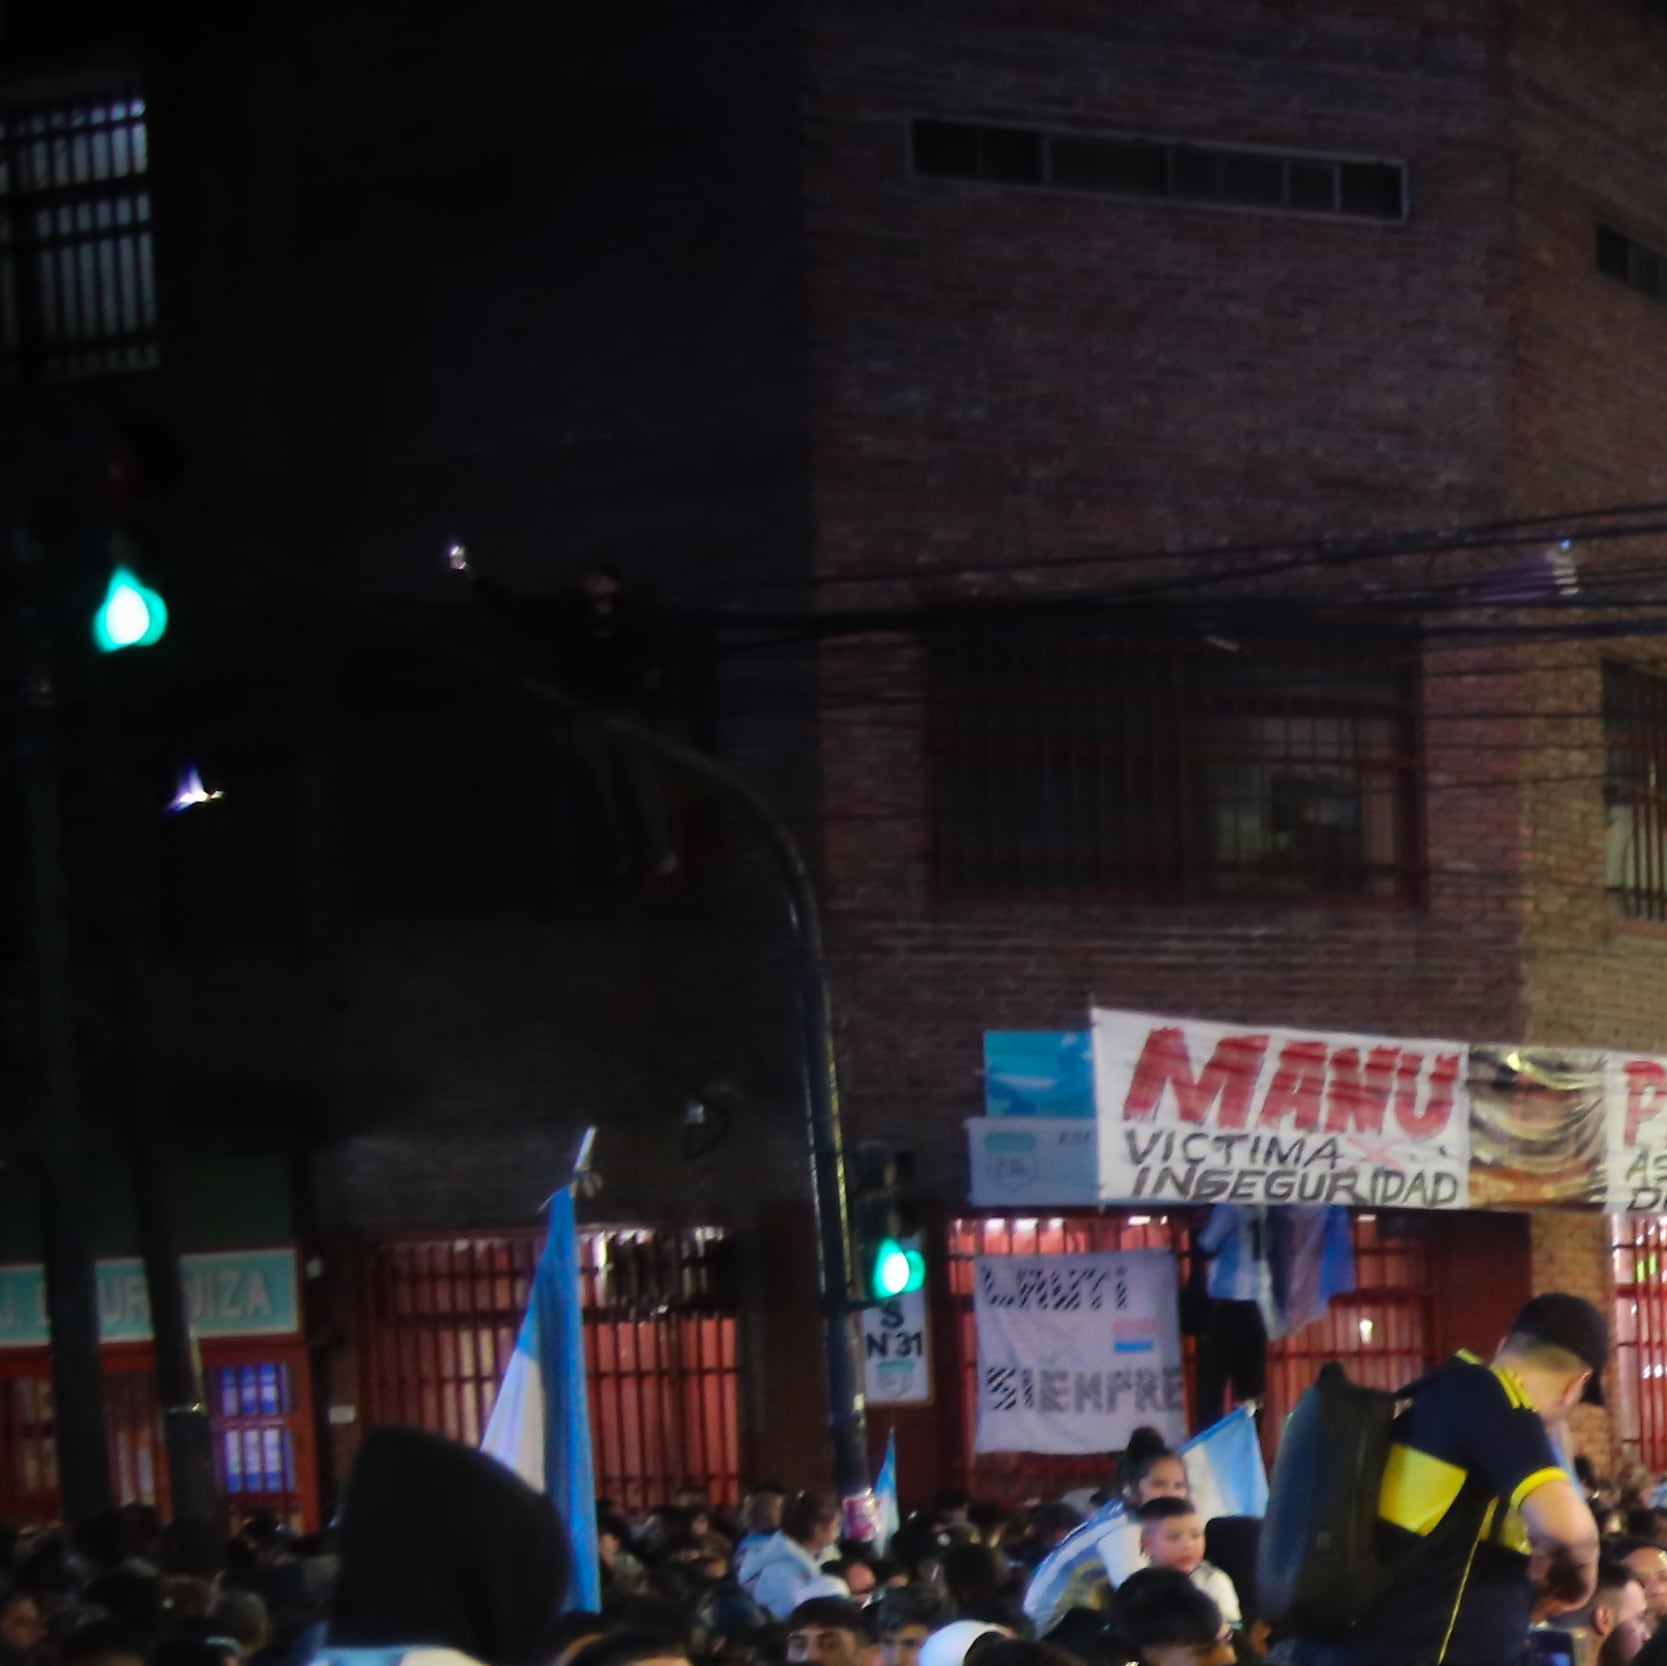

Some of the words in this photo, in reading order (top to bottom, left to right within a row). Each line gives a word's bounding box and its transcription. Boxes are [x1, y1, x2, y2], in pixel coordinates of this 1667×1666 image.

[1123, 1026, 1461, 1138] MANU
[1124, 1130, 1343, 1169] VICTIMA
[1130, 1165, 1460, 1207] INSEGURIDAD
[866, 1332, 888, 1358] N
